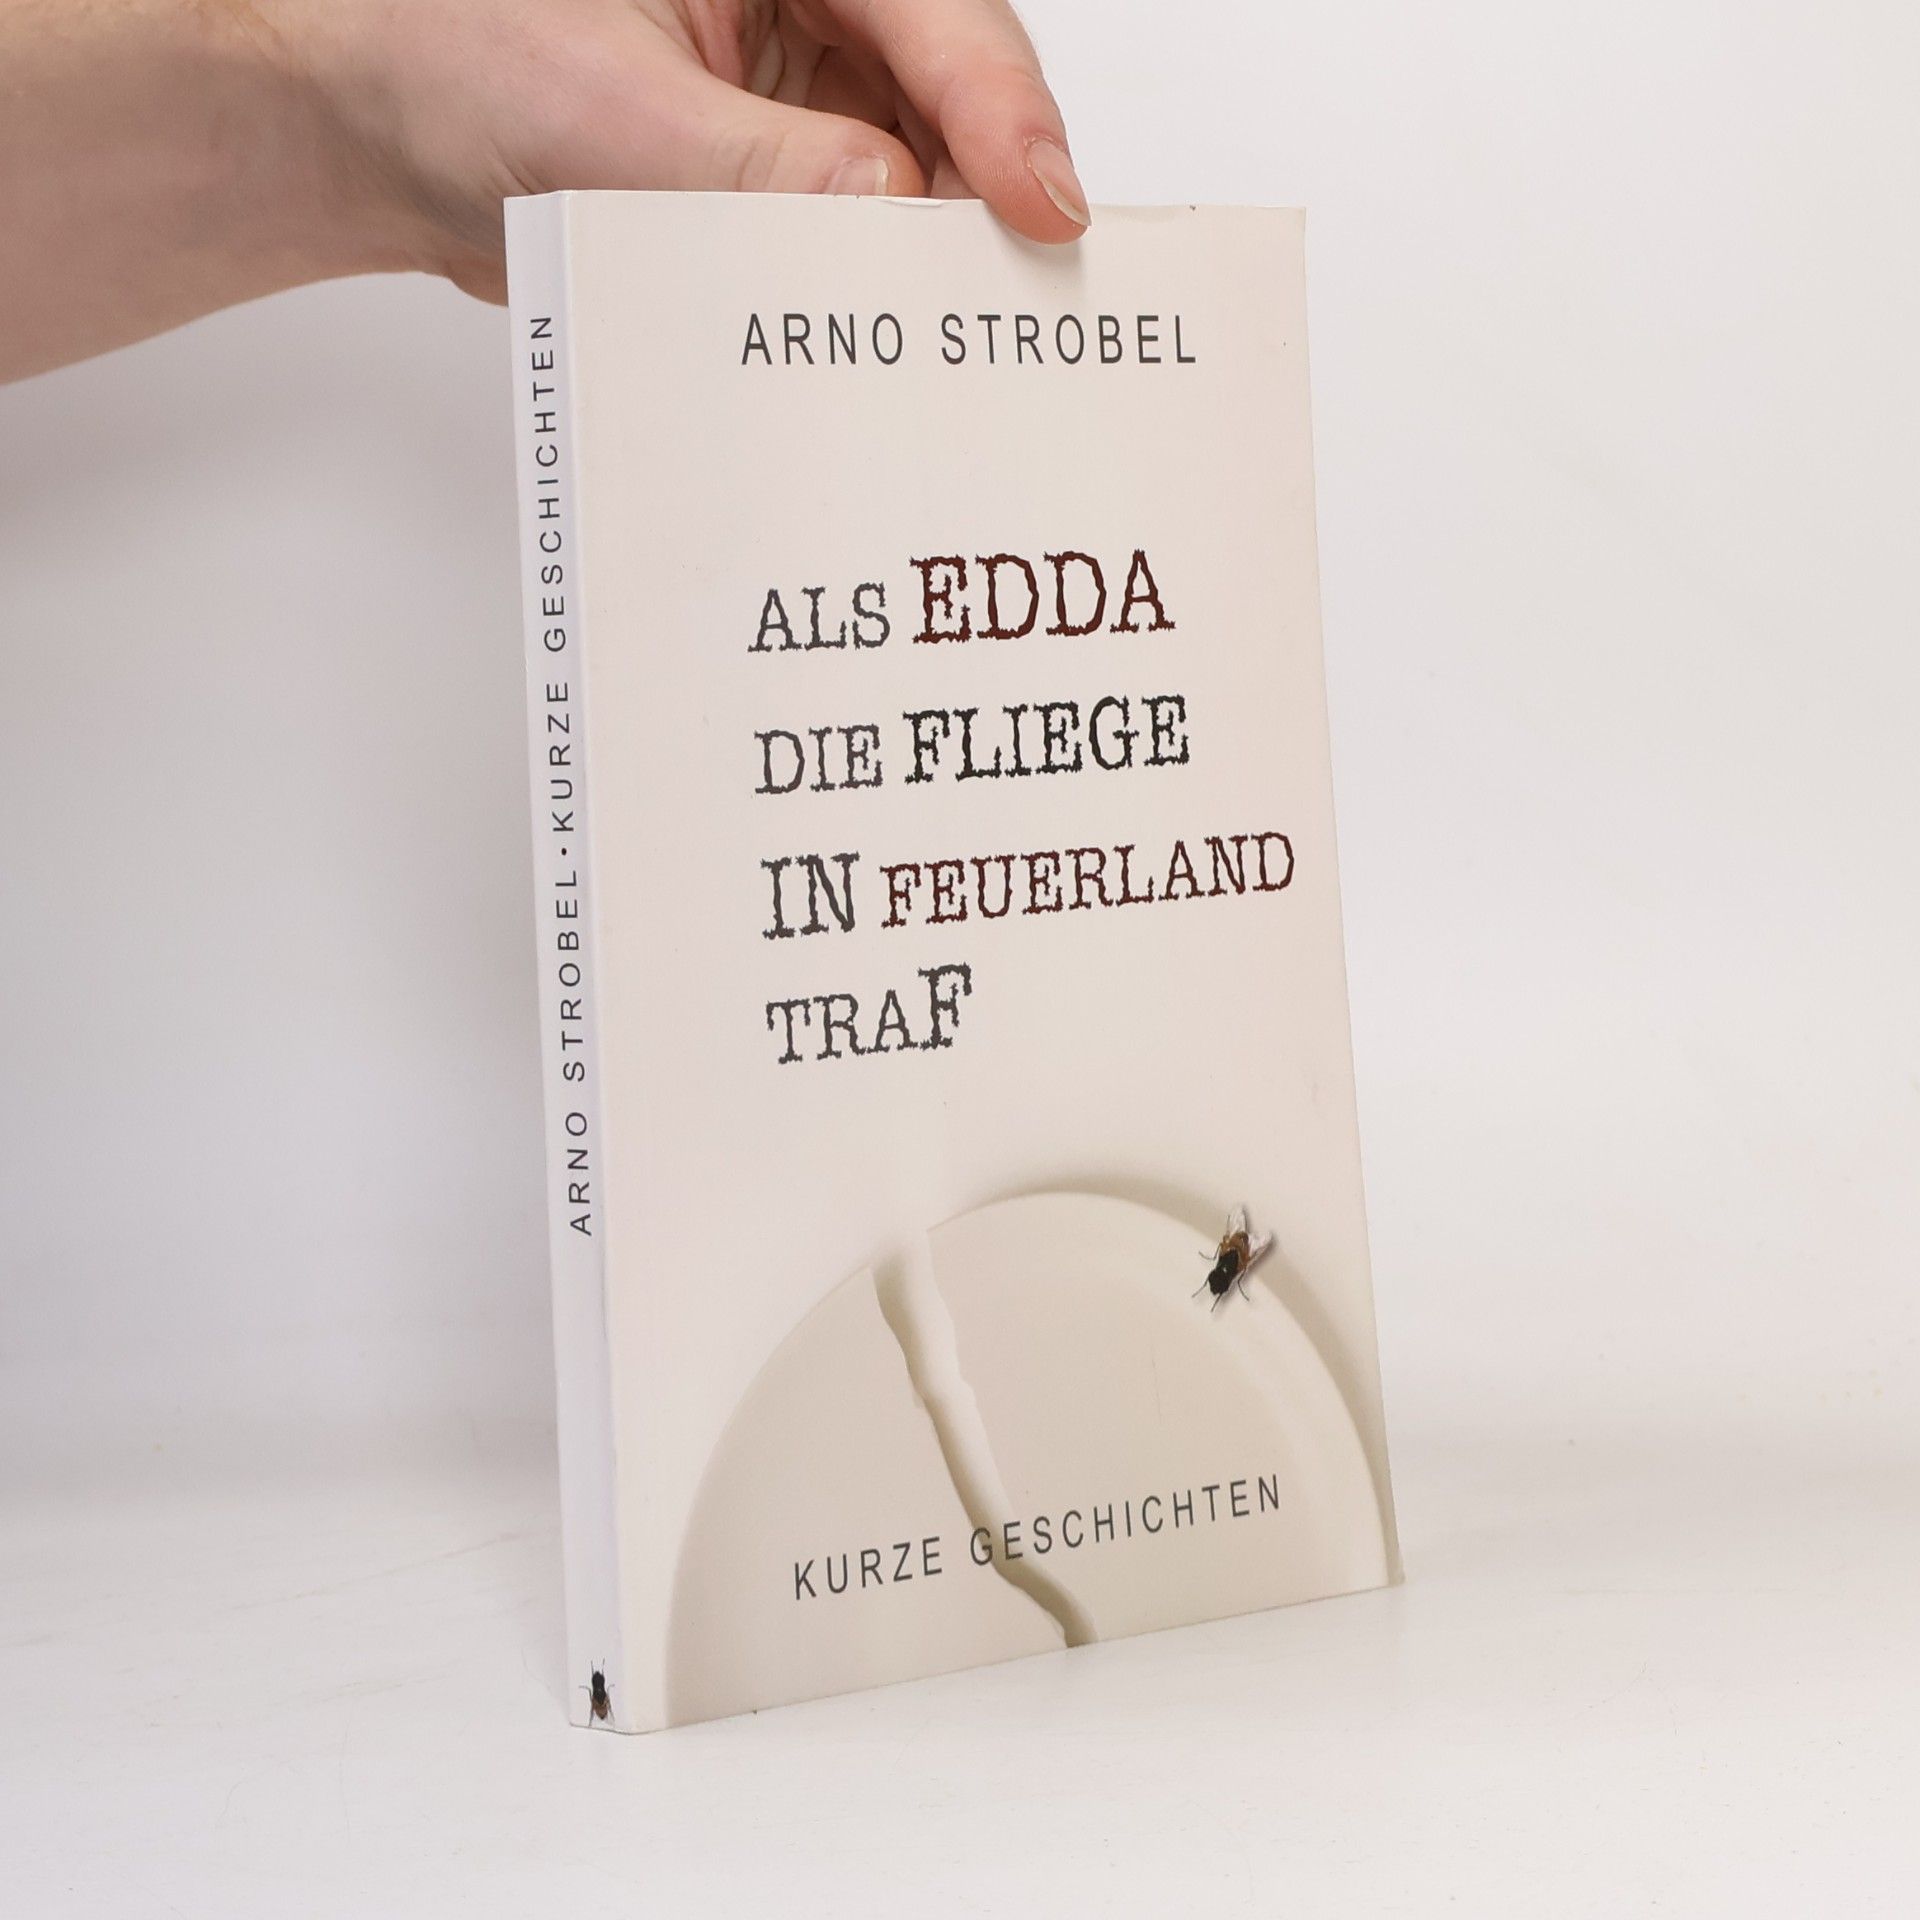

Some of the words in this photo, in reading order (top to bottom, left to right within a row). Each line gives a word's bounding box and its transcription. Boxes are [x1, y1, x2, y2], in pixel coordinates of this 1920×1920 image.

[741, 312, 904, 366] ARNO
[940, 312, 1197, 366] STROBEL
[529, 316, 567, 653] GESCHICHTEN
[747, 581, 891, 654] ALS
[908, 547, 1177, 645] EDDA
[545, 682, 575, 832] KURZE
[753, 722, 884, 796] DIE
[901, 693, 1191, 786] FLIEGE
[759, 850, 861, 941] IN
[878, 830, 1296, 930] FEUERLAND
[554, 870, 586, 1083] STROBEL
[765, 961, 973, 1066] TRAF
[564, 1111, 592, 1237] ARNO
[794, 1536, 943, 1601] KURZE
[969, 1473, 1280, 1568] GESCHICHTEN
